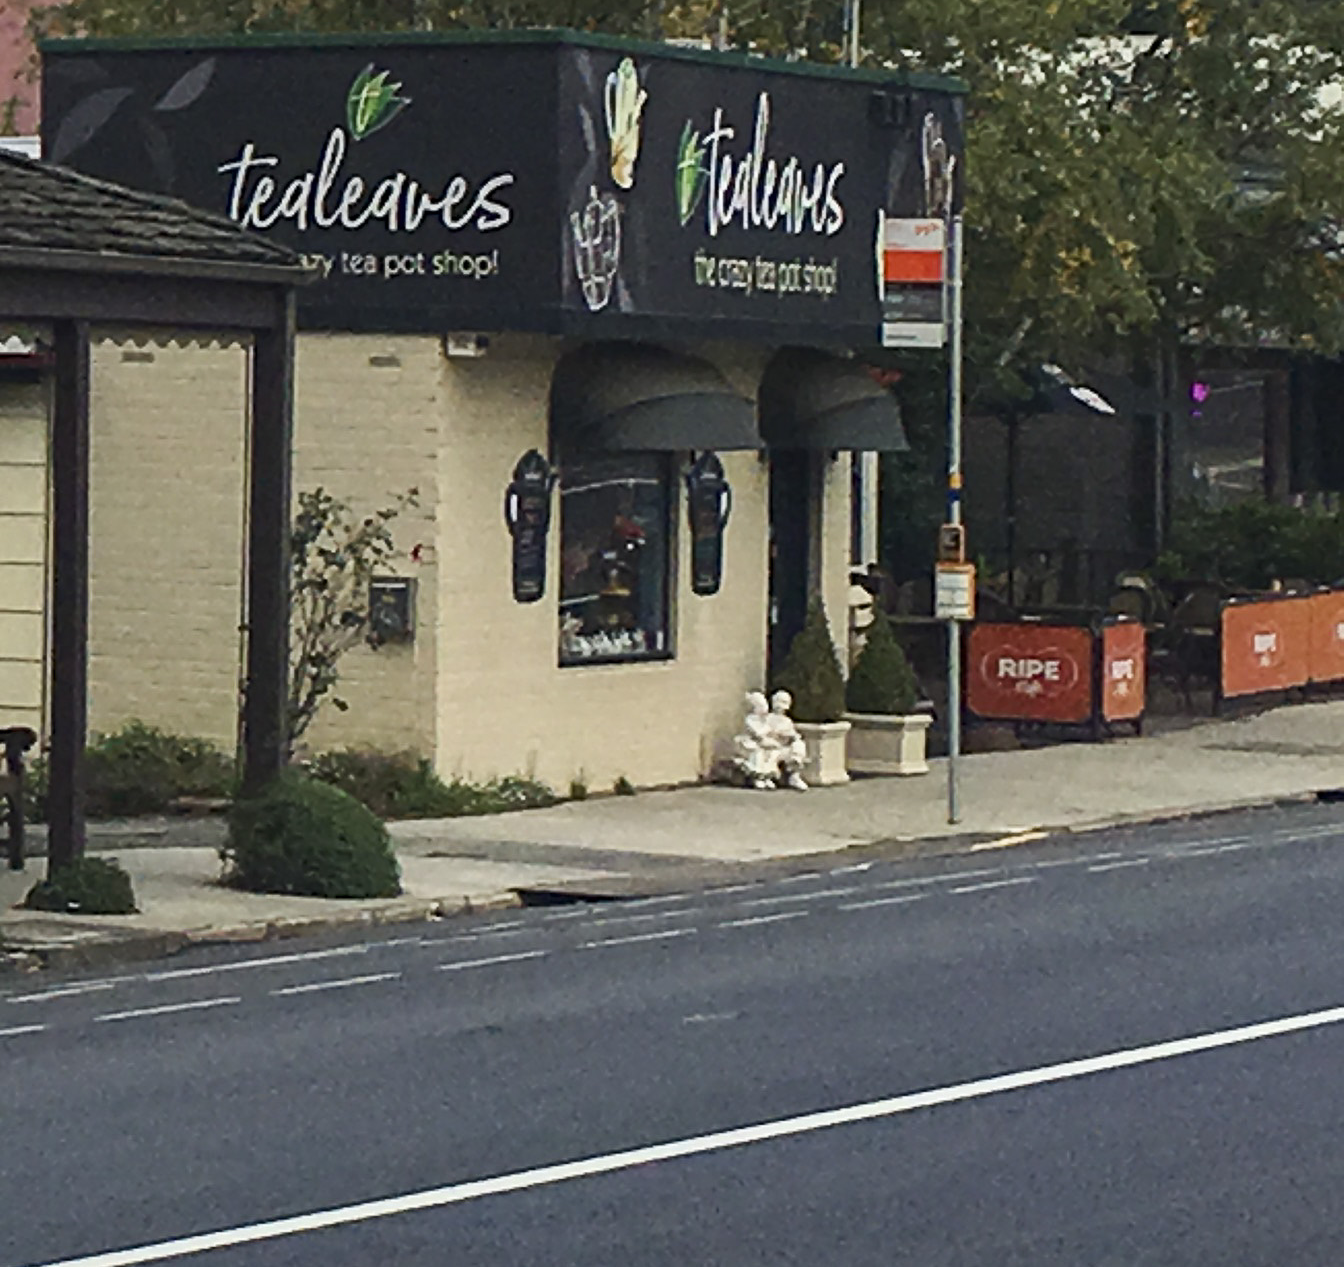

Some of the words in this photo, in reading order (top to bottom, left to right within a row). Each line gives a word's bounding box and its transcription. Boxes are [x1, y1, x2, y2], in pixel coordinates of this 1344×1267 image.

[218, 127, 514, 230] tealeaves
[702, 92, 845, 236] tealeaves
[341, 251, 377, 274] tea
[384, 252, 425, 279] pot
[432, 249, 499, 280] shop!
[998, 659, 1060, 681] RIPE
